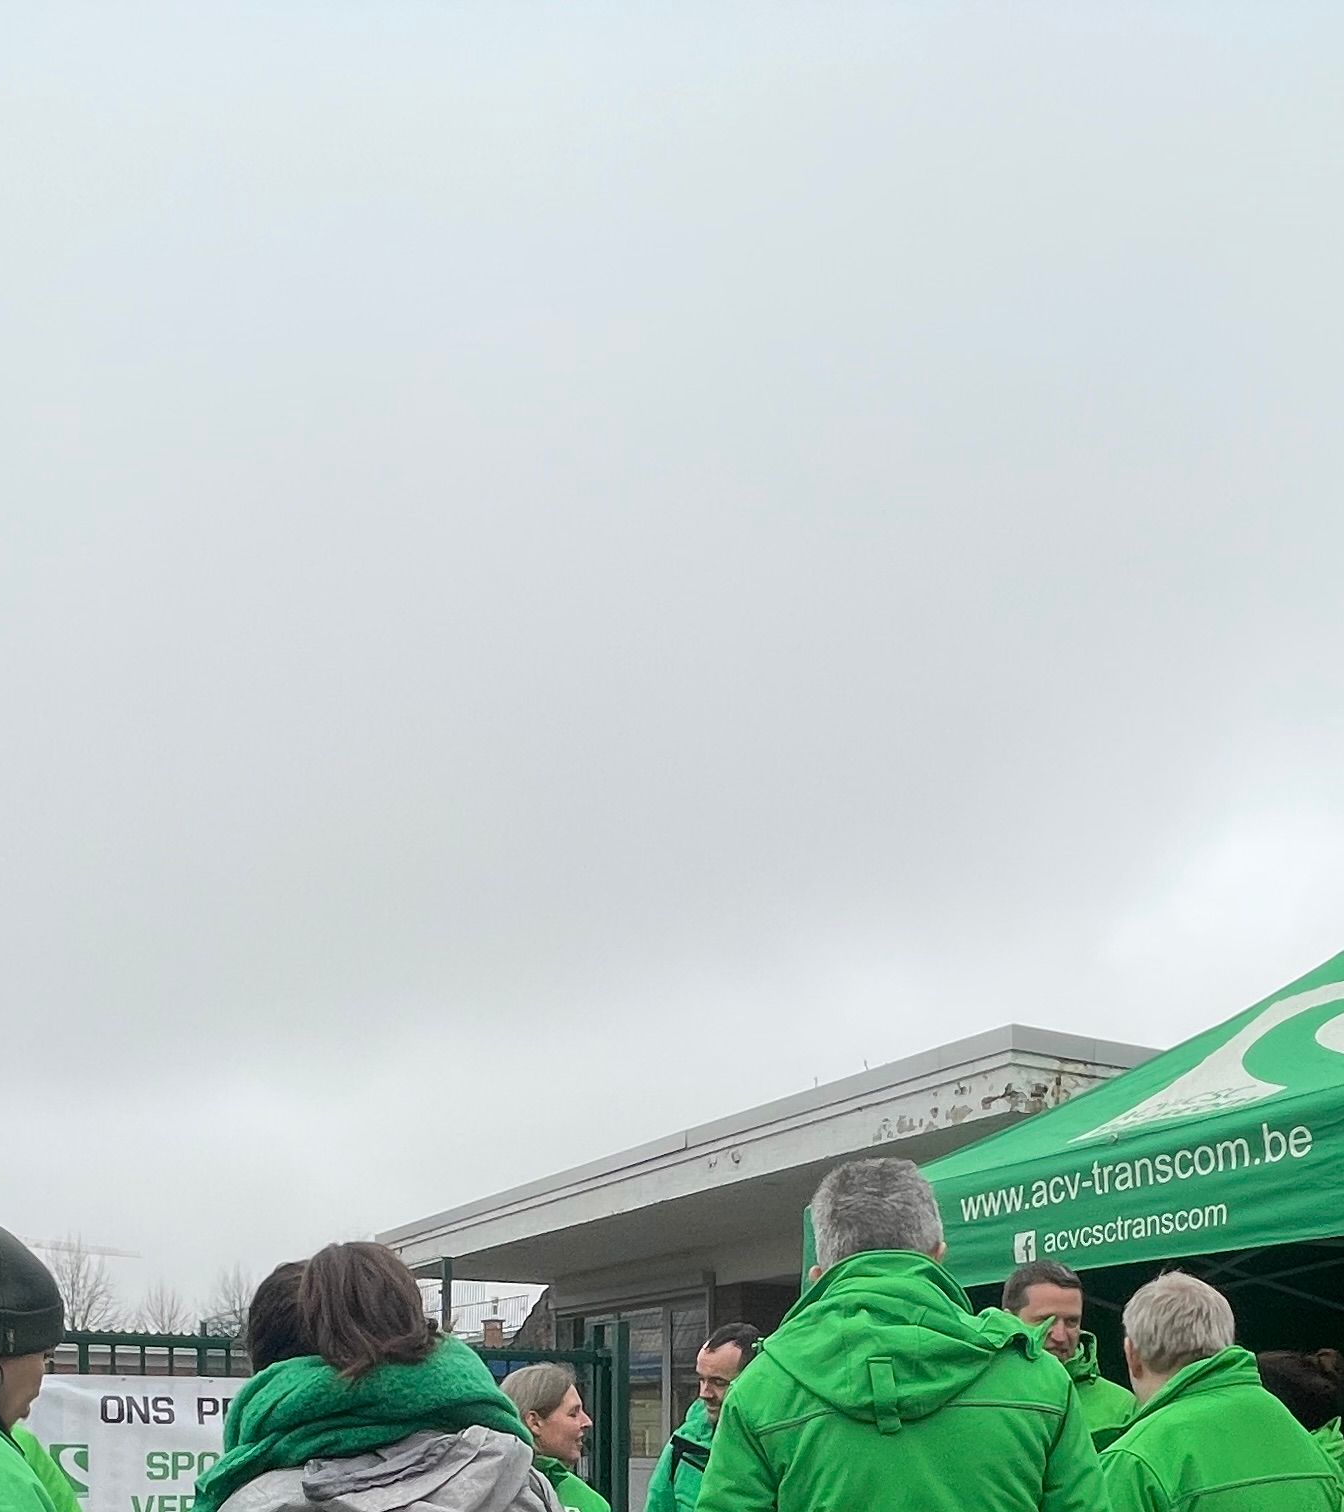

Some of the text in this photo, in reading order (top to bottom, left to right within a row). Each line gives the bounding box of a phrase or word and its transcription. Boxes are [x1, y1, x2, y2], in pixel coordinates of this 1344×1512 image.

[960, 1123, 1314, 1222] www.acv-transcom.be
[1044, 1203, 1228, 1253] acvcsctranscom
[100, 1395, 176, 1425] ONS
